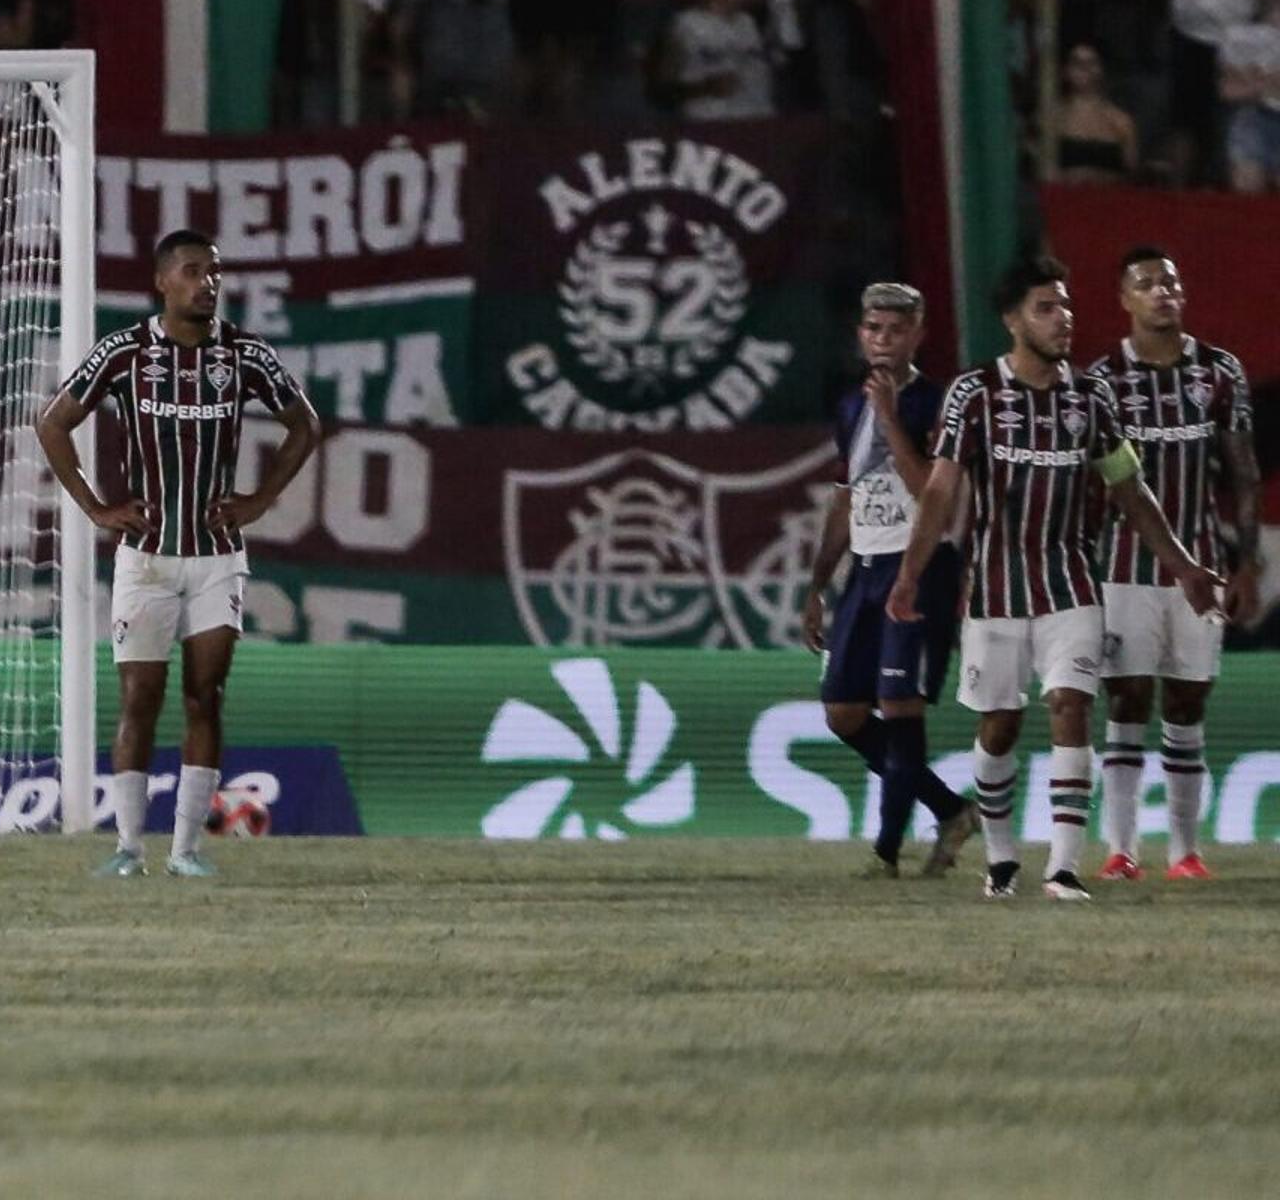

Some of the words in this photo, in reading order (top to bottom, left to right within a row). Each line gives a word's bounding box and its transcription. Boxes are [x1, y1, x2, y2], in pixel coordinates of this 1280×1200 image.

[96, 136, 467, 262] ITERÓI
[538, 137, 789, 234] ALENTO
[593, 255, 718, 343] 52
[80, 331, 136, 382] ZINZANE
[140, 399, 235, 420] SUPERBET
